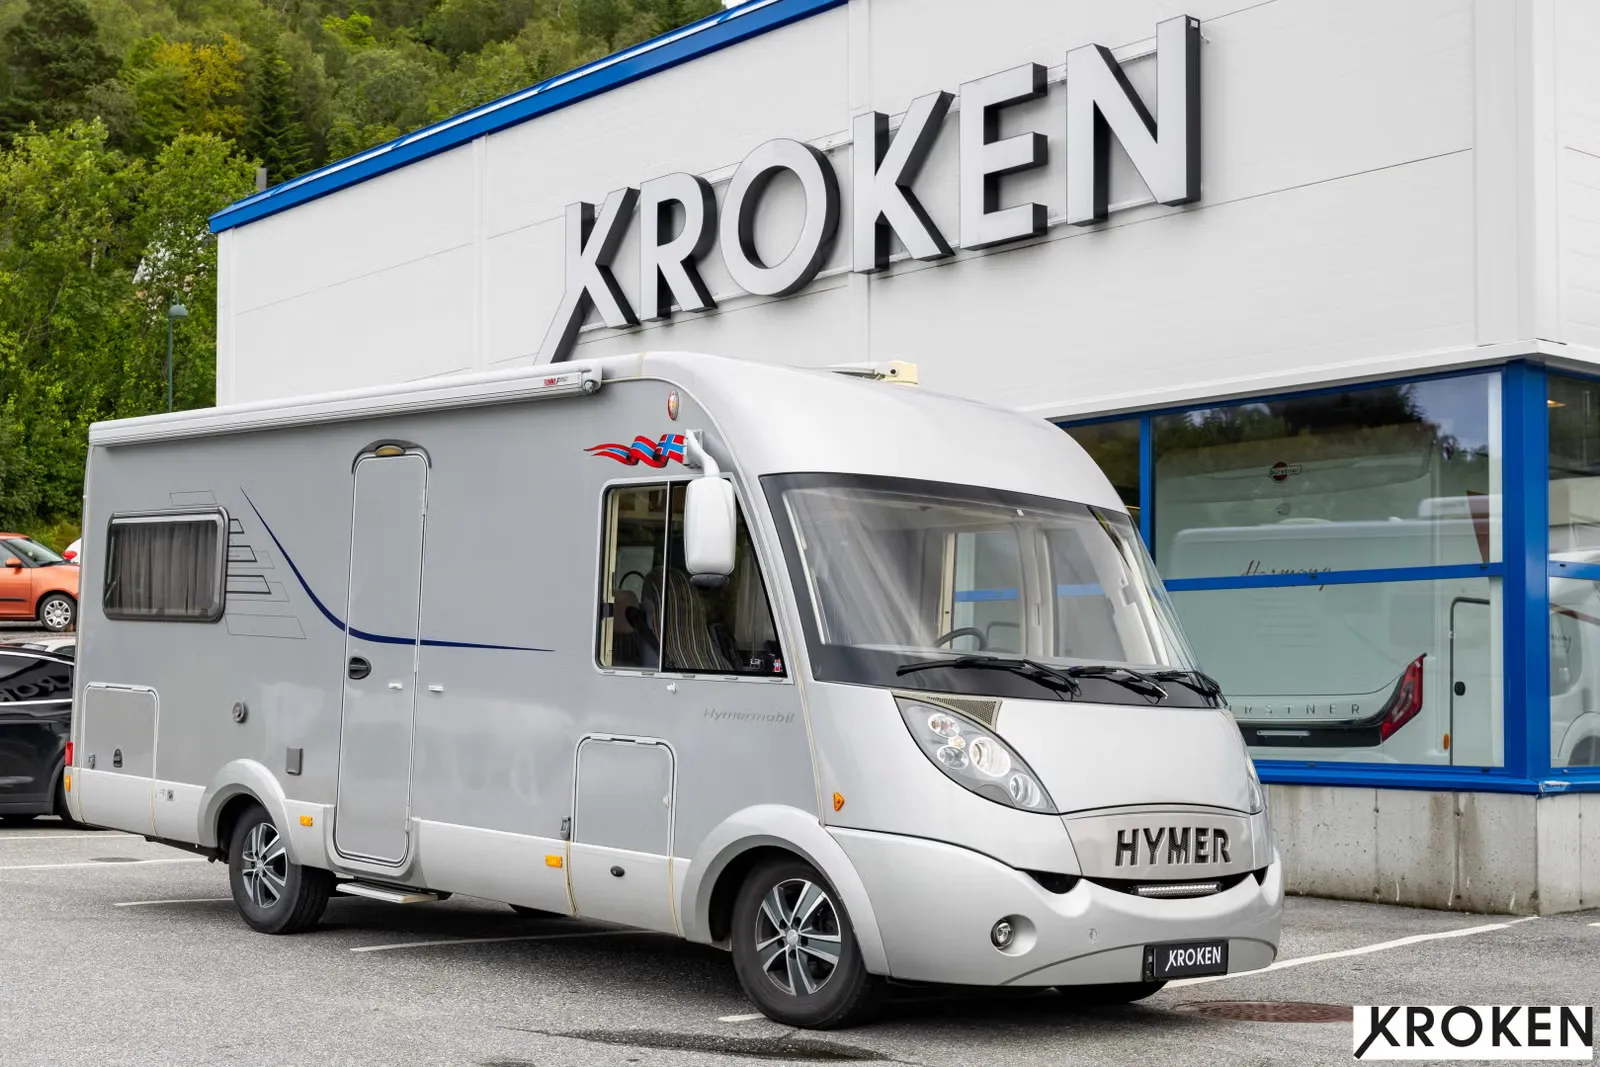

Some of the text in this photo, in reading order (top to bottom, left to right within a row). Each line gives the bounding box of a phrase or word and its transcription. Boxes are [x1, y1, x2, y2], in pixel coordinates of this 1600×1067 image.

[533, 14, 1200, 365] KROKEN
[703, 708, 795, 723] Hymermobil
[1115, 826, 1232, 867] HYMER
[1165, 946, 1221, 972] KROKEN
